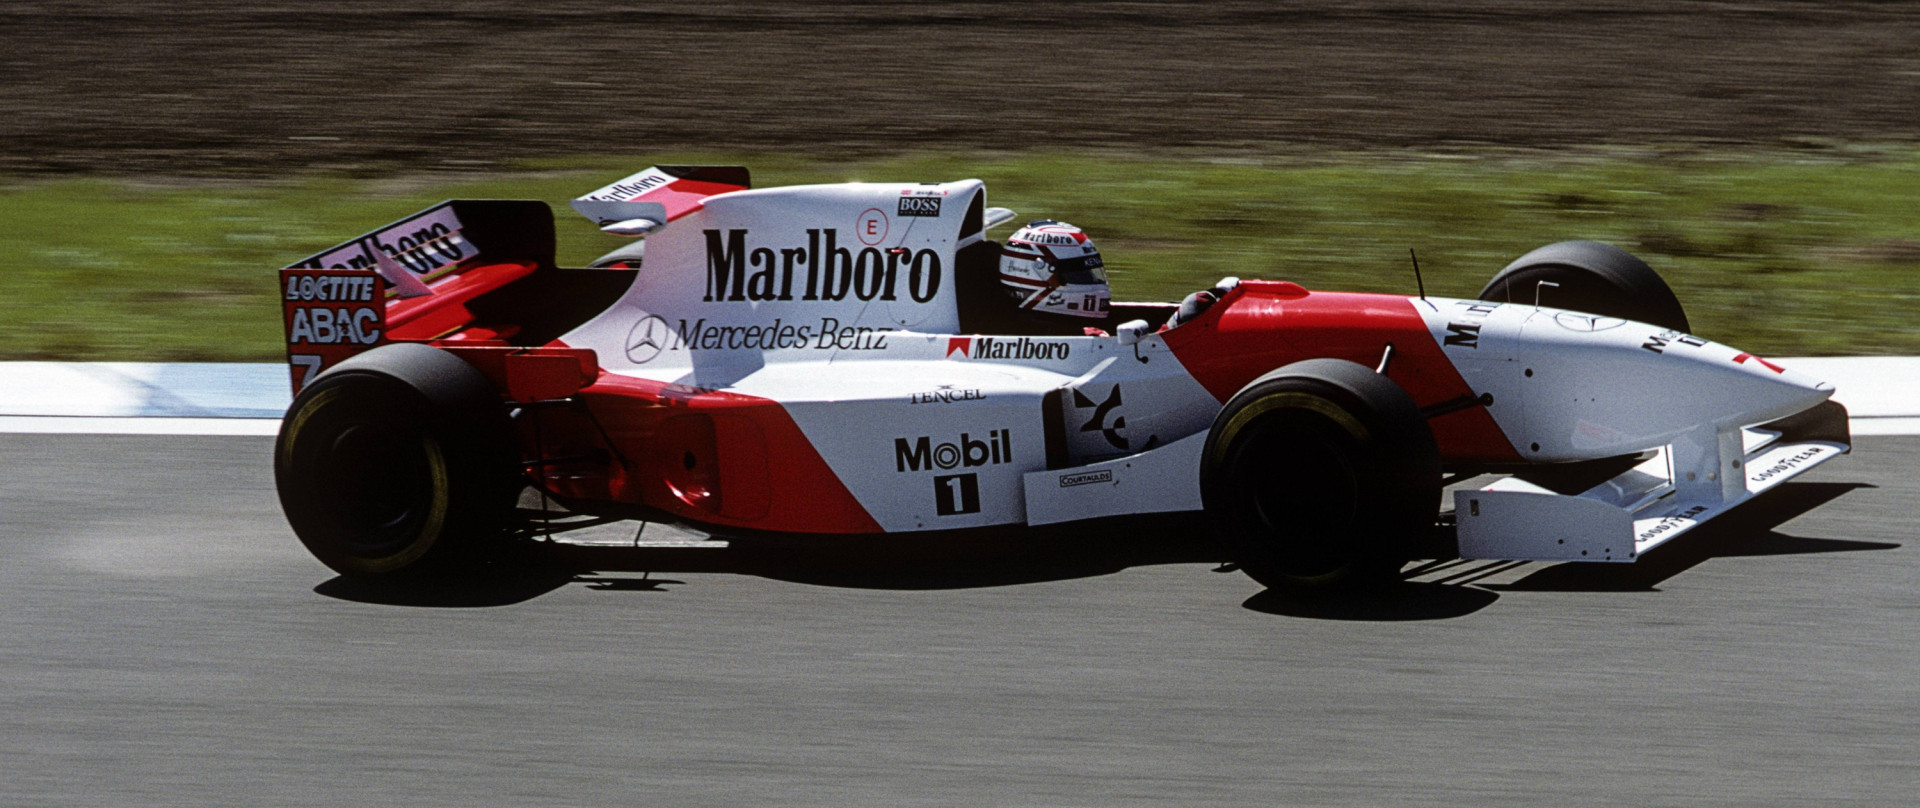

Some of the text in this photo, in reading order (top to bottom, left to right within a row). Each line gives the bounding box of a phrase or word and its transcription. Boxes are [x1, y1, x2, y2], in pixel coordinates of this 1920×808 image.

[583, 175, 665, 201] arlboro
[900, 198, 939, 211] BOSS
[866, 219, 878, 235] E
[1023, 231, 1073, 245] Marlboro
[703, 228, 942, 304] Marlboro
[286, 275, 375, 301] LOCTITE
[290, 307, 380, 345] ABAC
[670, 317, 893, 350] Mercedes-Benz
[973, 338, 1070, 360] Marlboro
[290, 355, 323, 389] 7
[907, 388, 987, 405] TENCEL
[895, 428, 1012, 473] Mobil
[1751, 447, 1824, 482] GOODYEAR
[1062, 473, 1110, 485] COURTAULDS
[946, 476, 965, 513] 1
